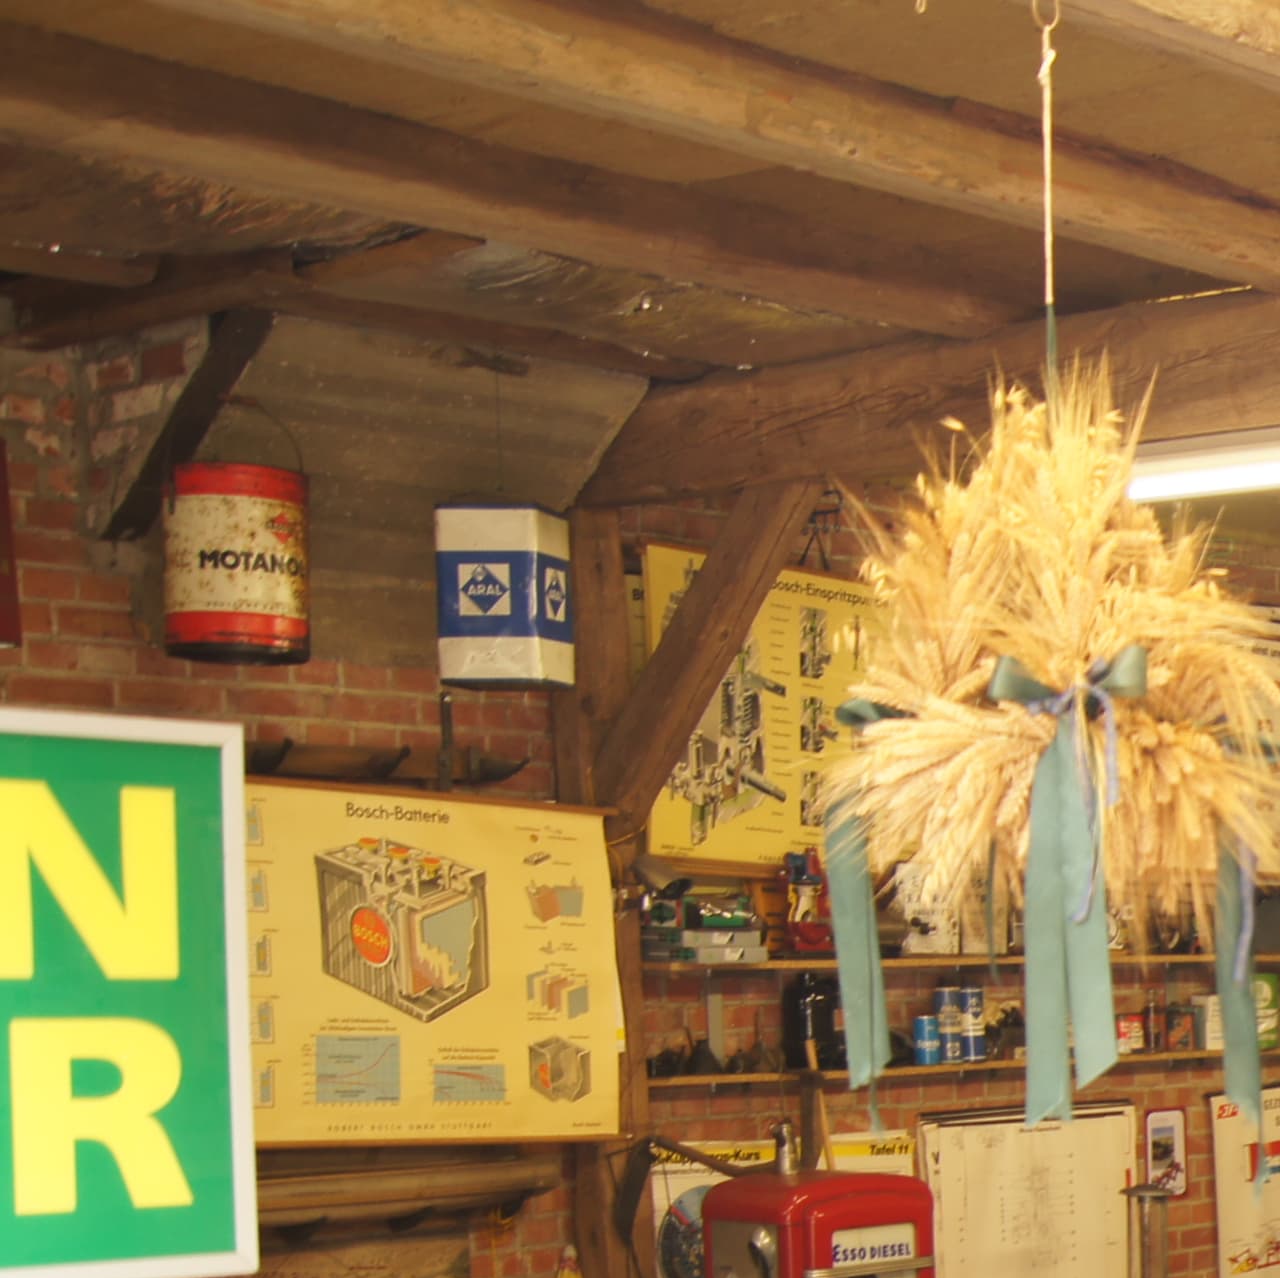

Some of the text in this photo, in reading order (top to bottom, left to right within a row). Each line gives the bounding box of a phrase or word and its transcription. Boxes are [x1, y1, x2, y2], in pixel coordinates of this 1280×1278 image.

[467, 583, 503, 596] ARAL
[345, 801, 450, 825] Bosch-Batterie
[869, 1242, 912, 1259] DIESEL
